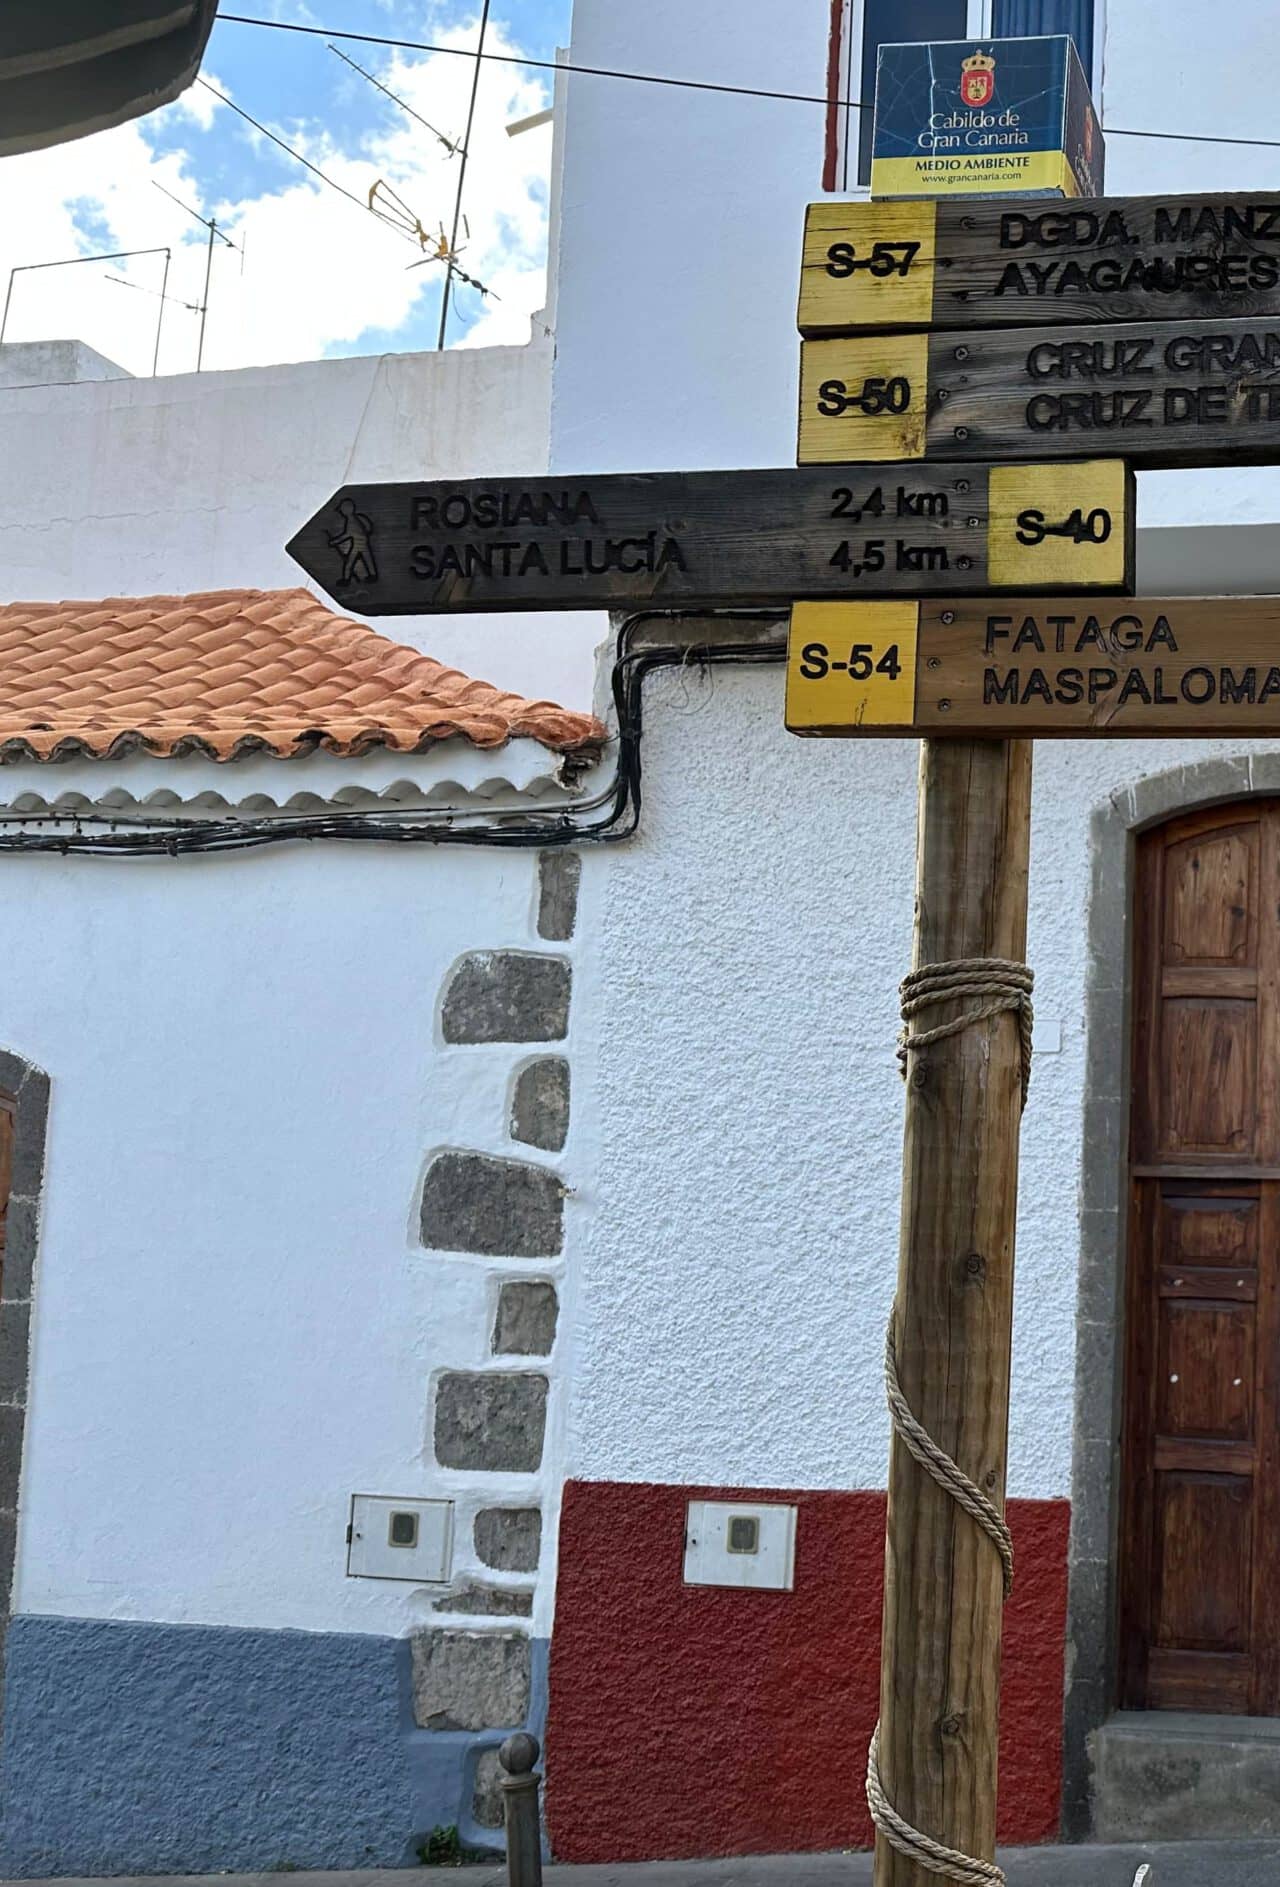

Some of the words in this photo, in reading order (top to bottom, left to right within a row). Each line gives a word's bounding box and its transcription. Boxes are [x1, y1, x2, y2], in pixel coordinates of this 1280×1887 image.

[918, 132, 960, 148] Gran
[965, 129, 1029, 147] Canaria
[929, 110, 995, 130] Cabildo
[998, 109, 1020, 127] de
[915, 159, 961, 171] MEDIO
[963, 156, 1030, 169] AMBIENTE
[921, 170, 1022, 184] www.grancanaria.com
[826, 241, 921, 279] S-57
[1026, 338, 1154, 379] CRUZ
[817, 376, 910, 417] S-50
[1025, 389, 1153, 432] CRUZ
[1163, 385, 1229, 426] DE
[412, 489, 599, 531] ROSIANA
[831, 486, 886, 524] 2,4
[896, 486, 948, 518] km
[1015, 507, 1112, 546] S-40
[408, 541, 549, 579] SANTA
[829, 540, 886, 577] 4,5
[896, 540, 949, 571] km
[985, 615, 1179, 653] FATAGA
[799, 643, 902, 681] S-54
